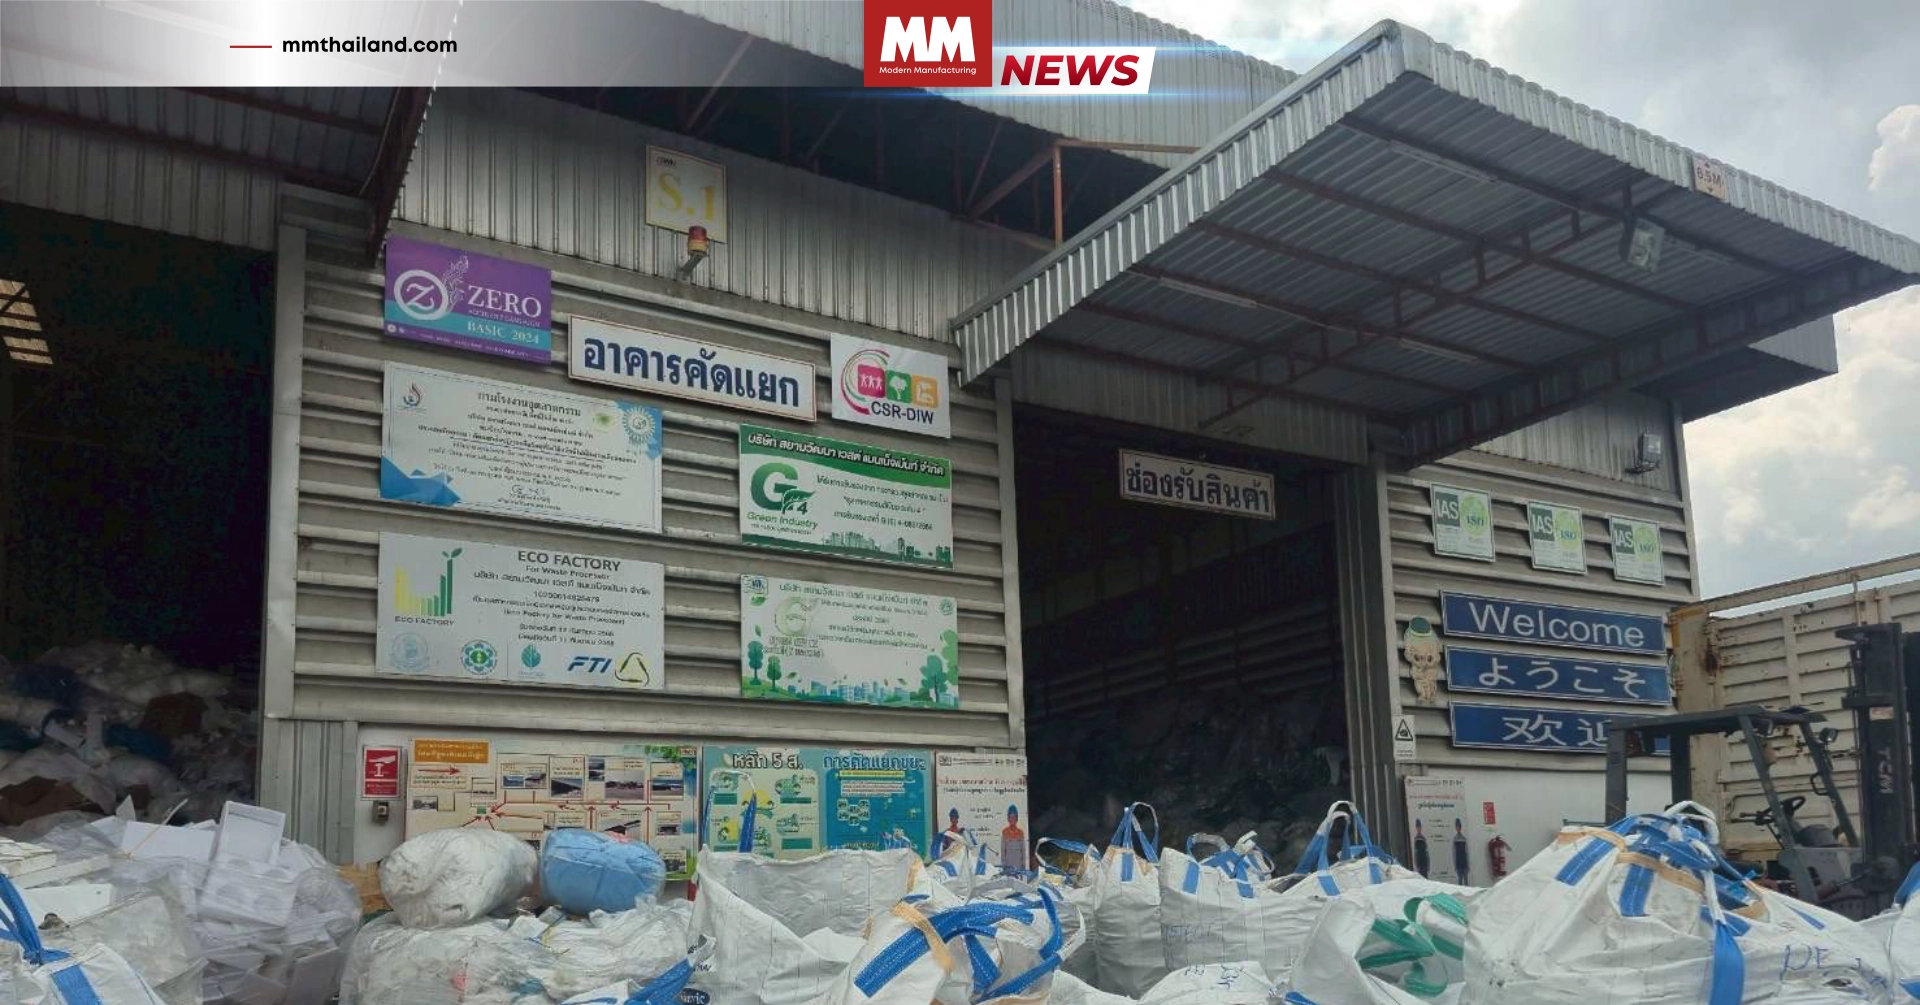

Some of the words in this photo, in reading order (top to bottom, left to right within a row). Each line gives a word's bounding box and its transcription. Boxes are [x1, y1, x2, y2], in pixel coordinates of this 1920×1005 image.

[467, 284, 542, 318] ZERO
[467, 321, 505, 338] BASIC
[511, 329, 540, 344] 2024
[584, 337, 799, 407] อาคารคัดแยก
[871, 401, 934, 424] CSR-DIW
[748, 433, 777, 448] บริษัท
[1126, 457, 1270, 513] ช่องรับสินค้า
[1436, 499, 1459, 520] IAS
[747, 511, 777, 523] Green
[780, 515, 819, 529] Industry
[1532, 513, 1554, 533] IAS
[1614, 529, 1634, 548] IAS
[518, 550, 549, 564] ECO
[554, 554, 621, 571] FACTORY
[526, 565, 540, 573] For
[542, 567, 569, 576] Waste
[394, 616, 414, 624] ECO
[415, 617, 455, 627] FACTORY
[1469, 602, 1645, 648] Welcome
[567, 655, 613, 674] FTI
[1478, 657, 1646, 699] ようこそ
[733, 751, 768, 769] หลัก
[772, 753, 782, 769] 5
[823, 751, 927, 771] การคัดแยกขยะ
